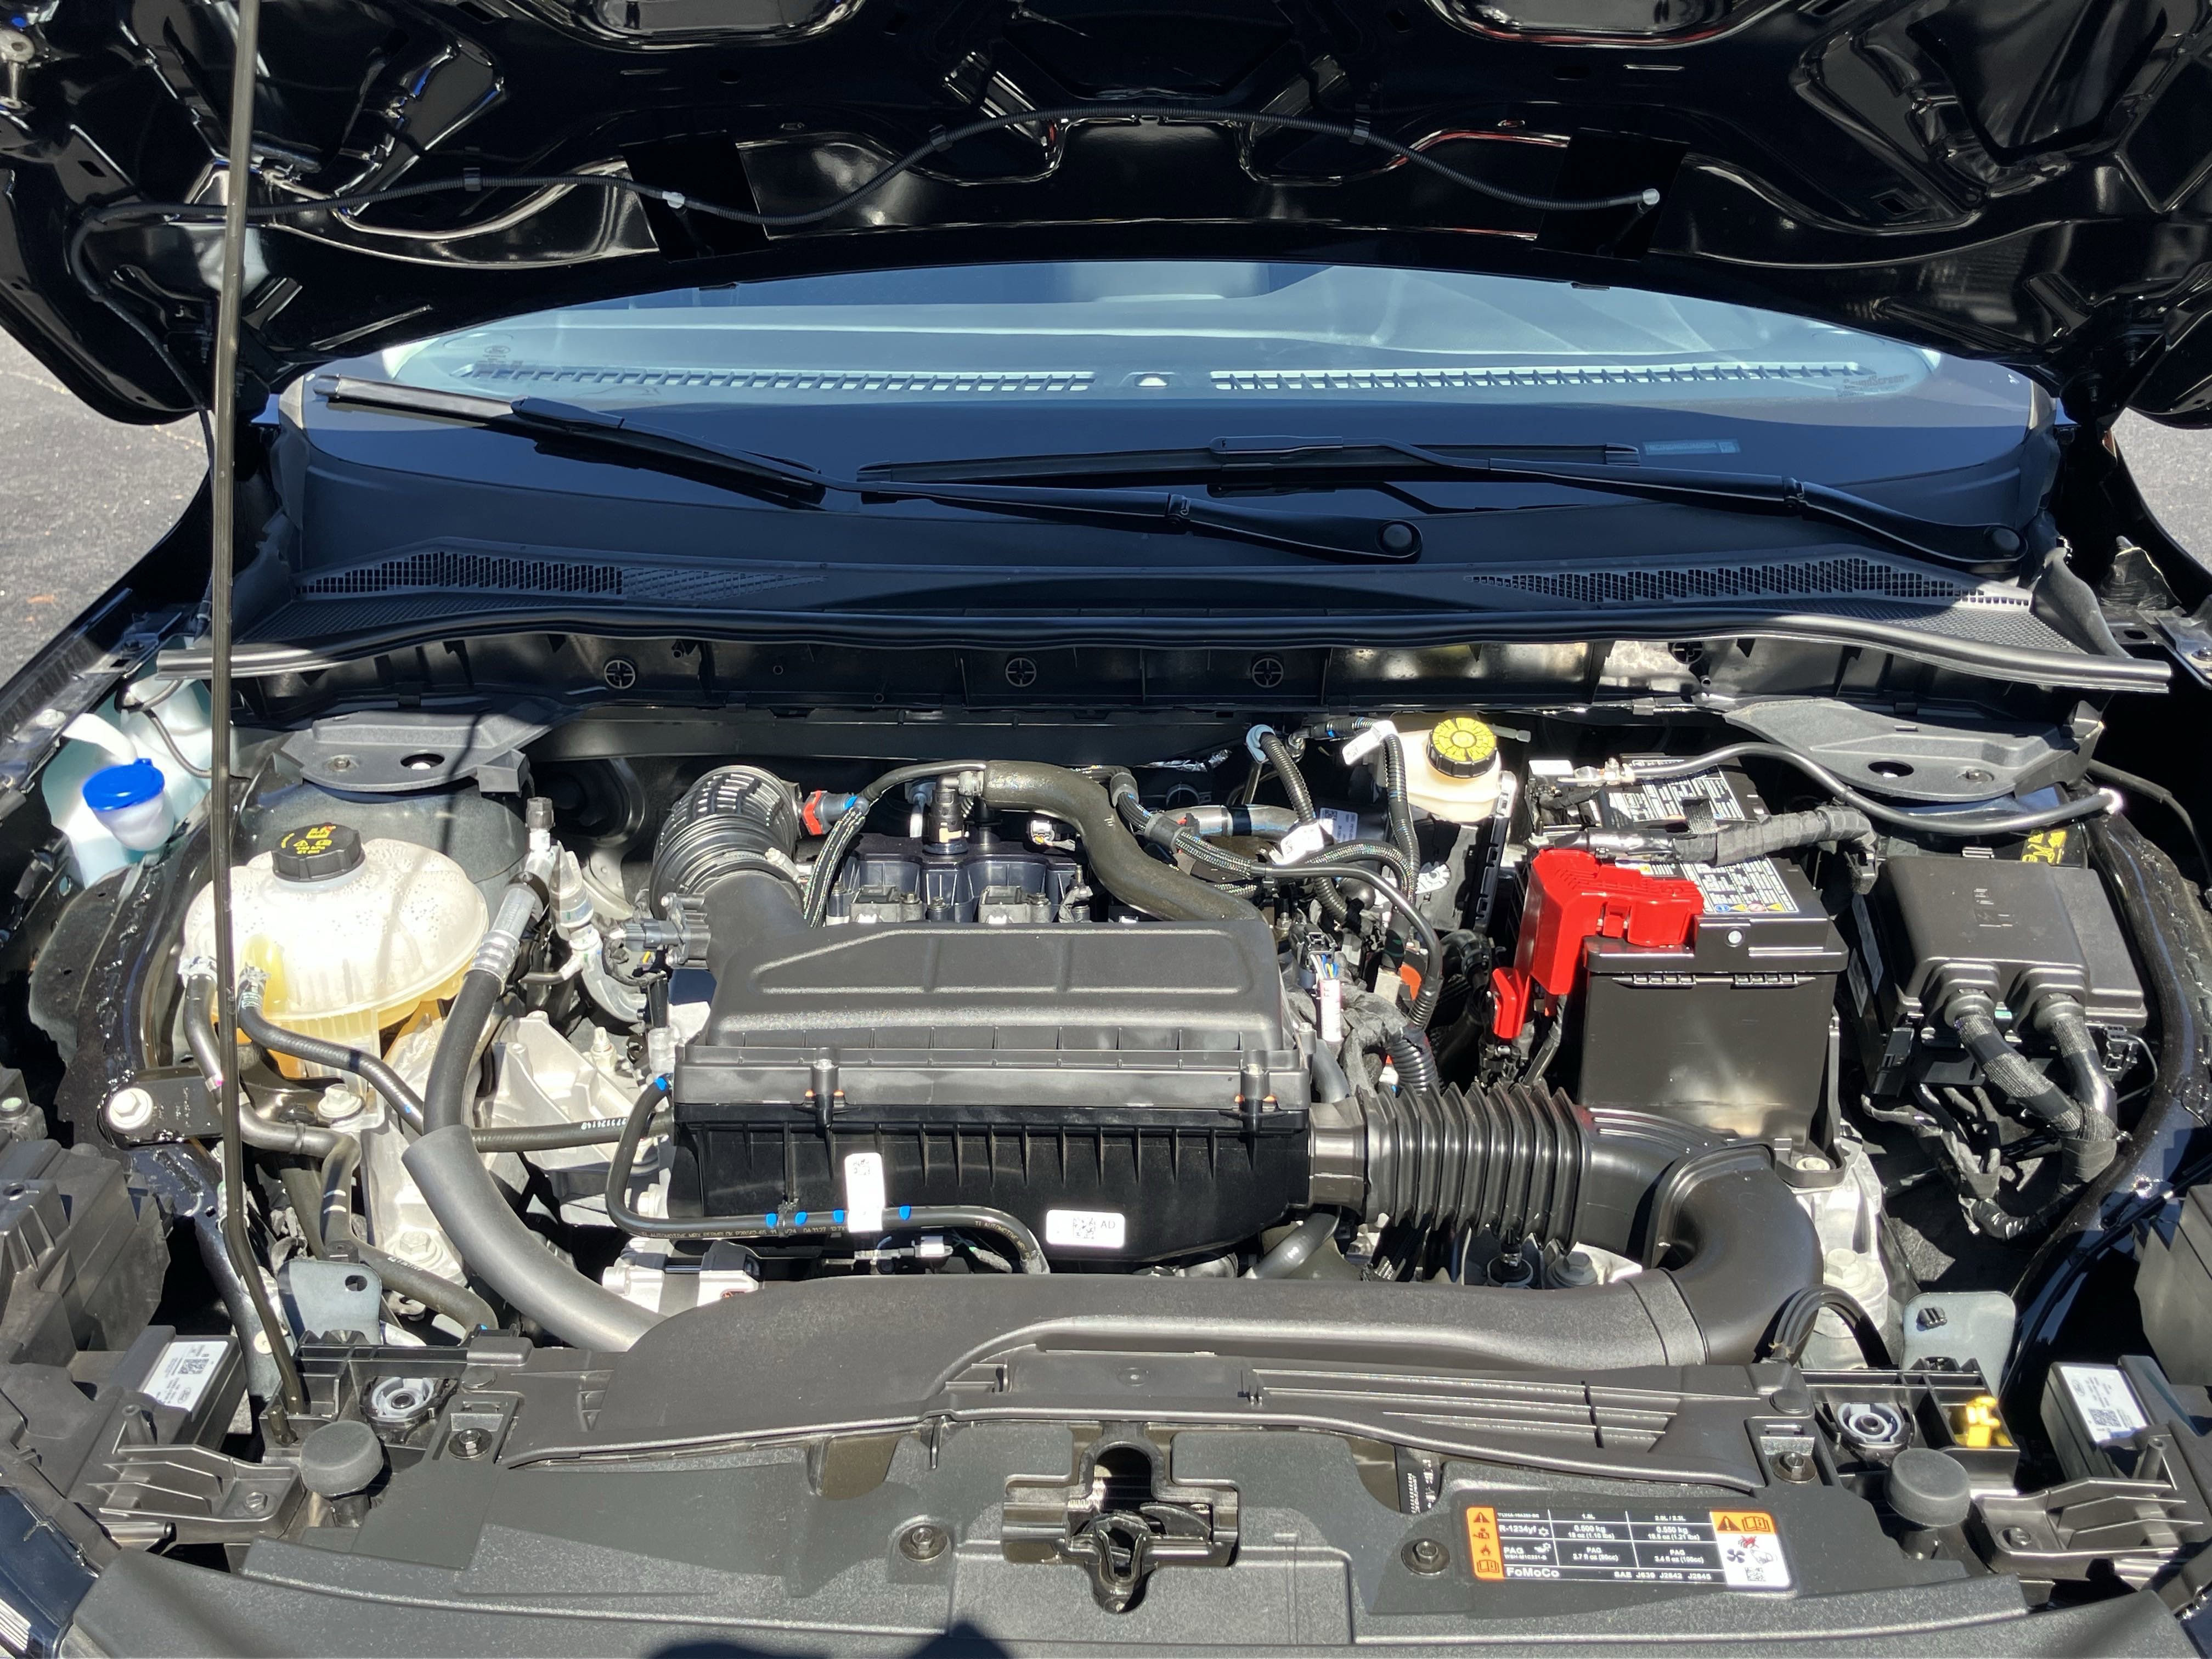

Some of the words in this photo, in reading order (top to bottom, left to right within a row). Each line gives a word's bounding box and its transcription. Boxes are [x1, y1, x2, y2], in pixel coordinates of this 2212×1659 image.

[1498, 1525, 1537, 1535] R-1234yf
[1573, 1524, 1595, 1533] 0.500
[1595, 1525, 1606, 1534] kg
[1656, 1526, 1677, 1534] 0.550
[1678, 1526, 1689, 1535] kg
[1506, 1567, 1560, 1578] FoMoCo
